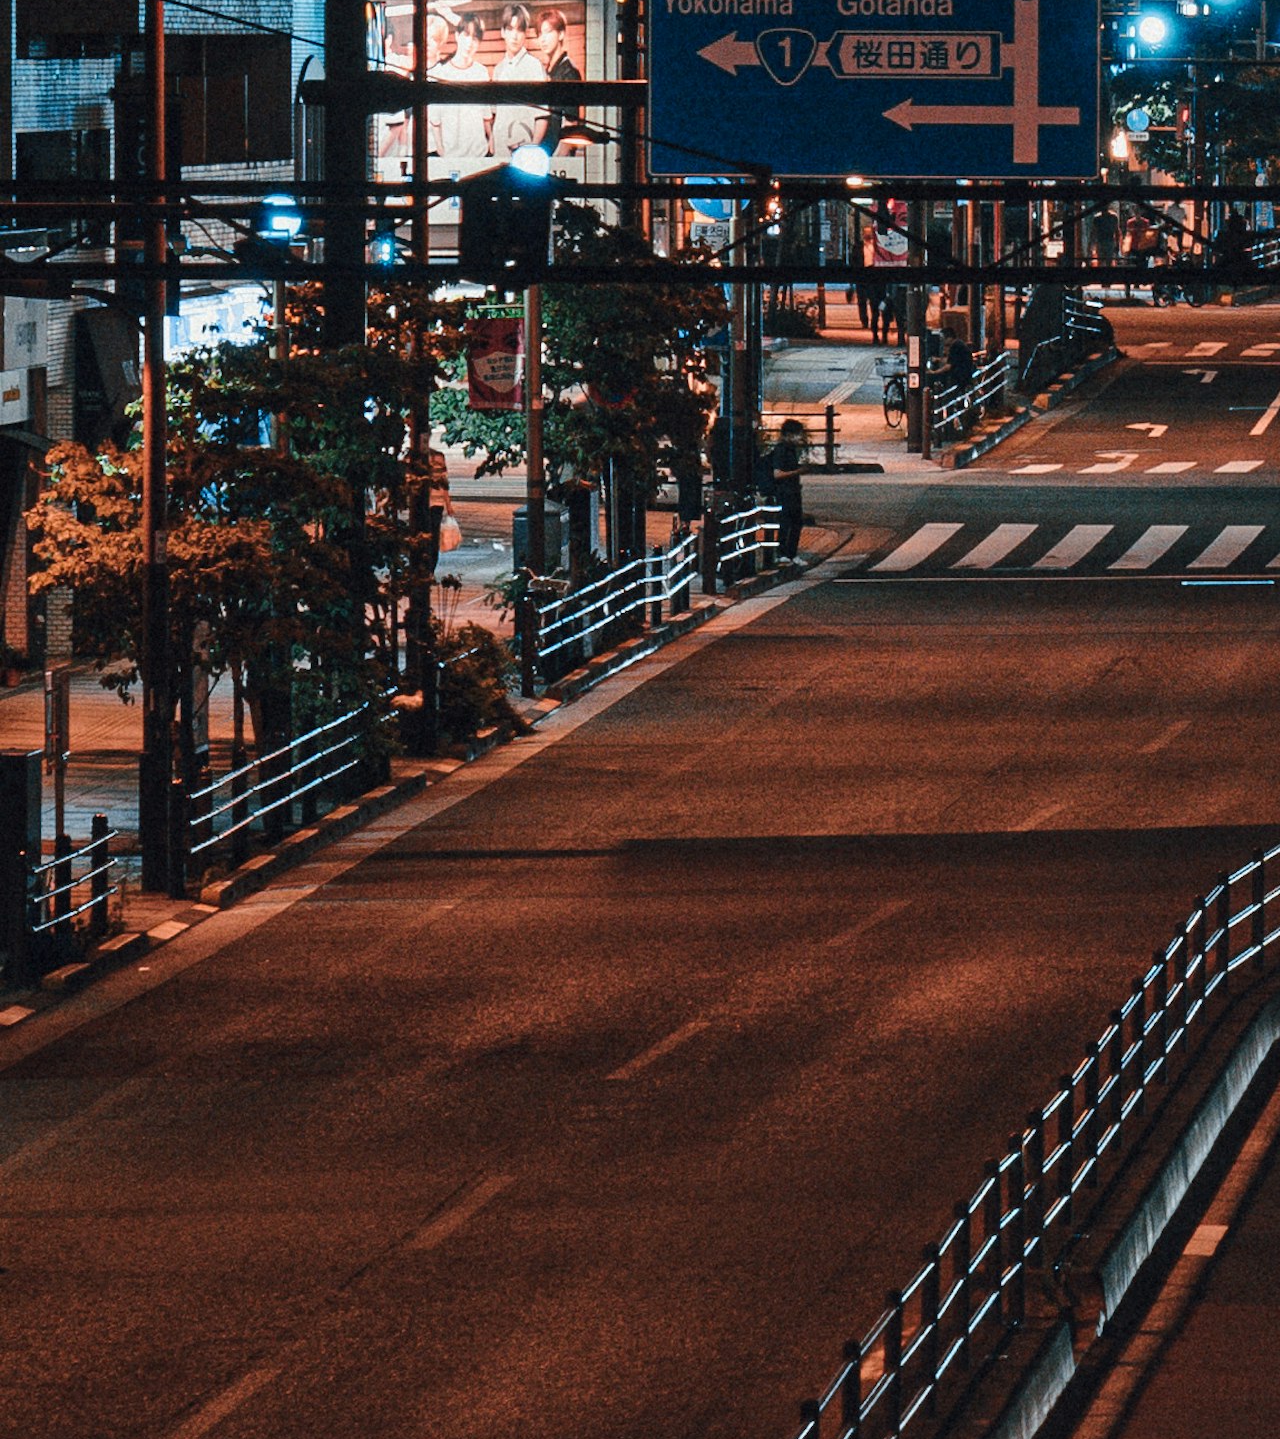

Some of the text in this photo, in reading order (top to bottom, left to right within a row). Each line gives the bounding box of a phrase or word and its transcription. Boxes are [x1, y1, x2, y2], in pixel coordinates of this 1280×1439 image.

[779, 37, 792, 67] 1
[852, 39, 983, 70] 桜田通り
